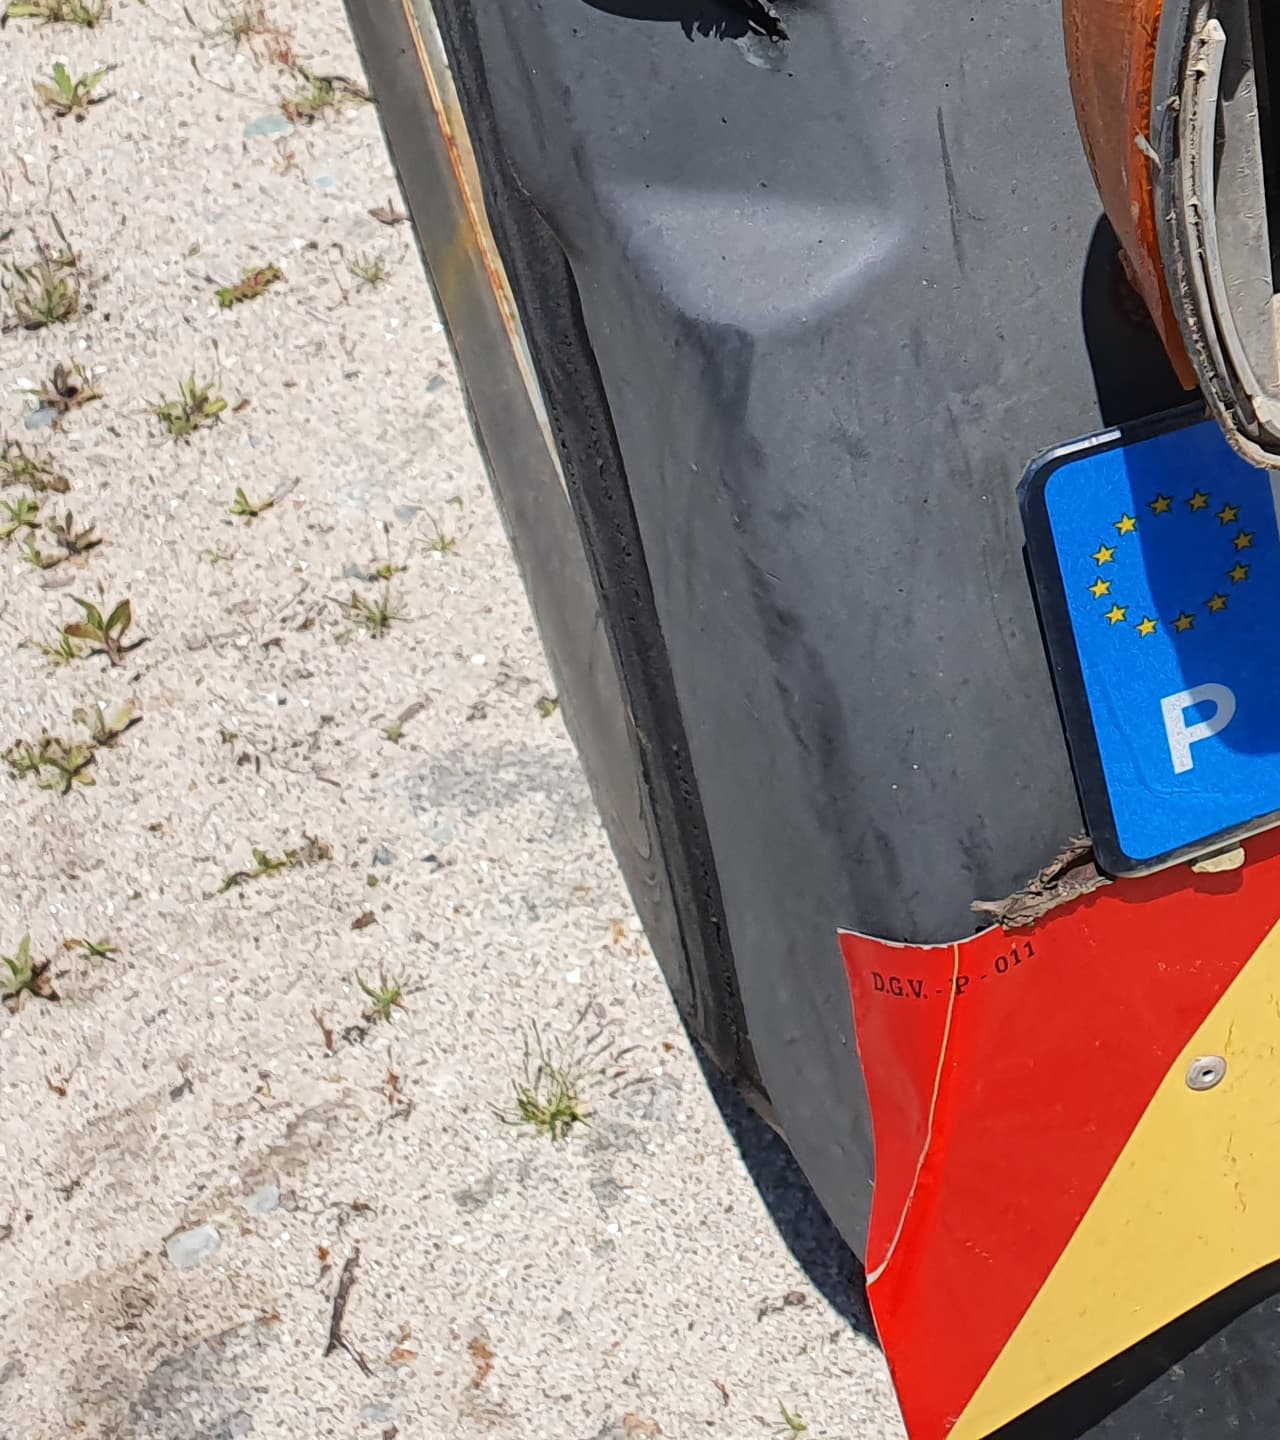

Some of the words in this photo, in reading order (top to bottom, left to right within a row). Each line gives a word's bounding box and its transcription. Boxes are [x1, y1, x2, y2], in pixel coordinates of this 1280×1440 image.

[1156, 681, 1237, 773] P
[871, 971, 928, 999] D.G.V.
[994, 941, 1036, 975] 011
